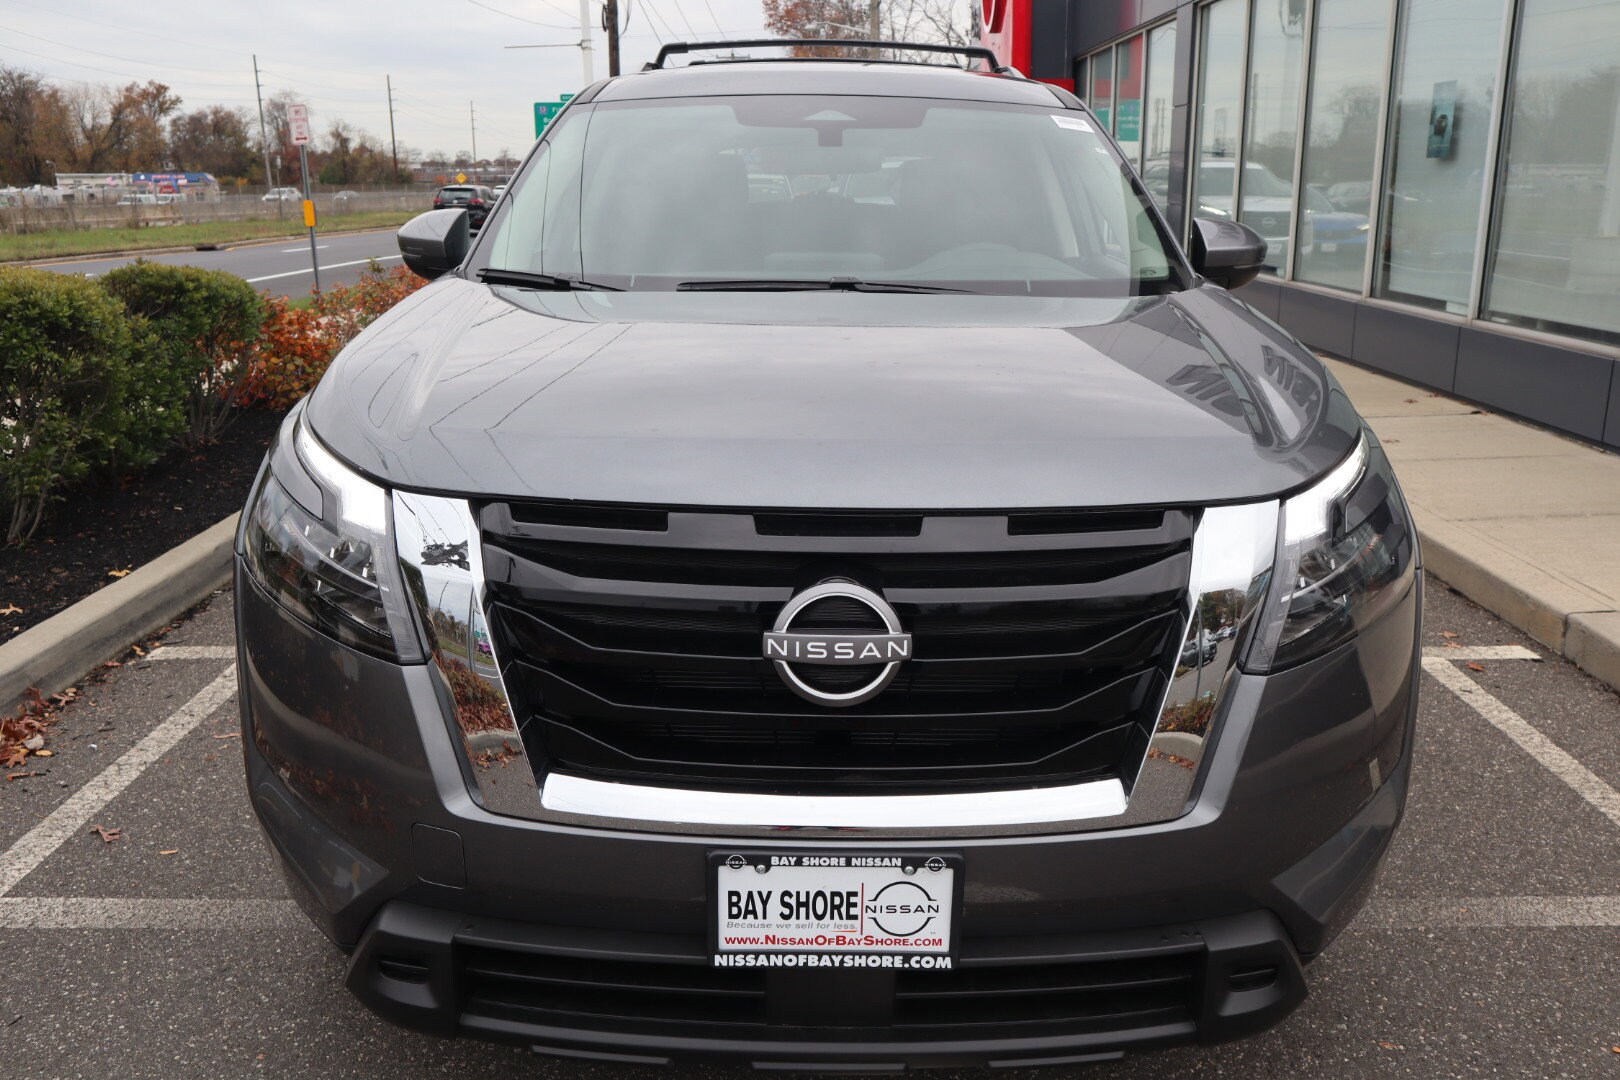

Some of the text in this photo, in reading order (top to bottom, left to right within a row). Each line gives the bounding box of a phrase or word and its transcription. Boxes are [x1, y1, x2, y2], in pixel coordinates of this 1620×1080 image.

[767, 638, 908, 659] NISSAN
[770, 856, 902, 867] BAY SHORE NISSAN
[727, 890, 859, 921] BAY SHORE
[865, 904, 939, 914] NISSAN
[726, 921, 772, 929] Because
[816, 921, 830, 929] for
[833, 922, 858, 930] less.
[714, 954, 952, 969] NISSANOFBAYSHORE.COM
